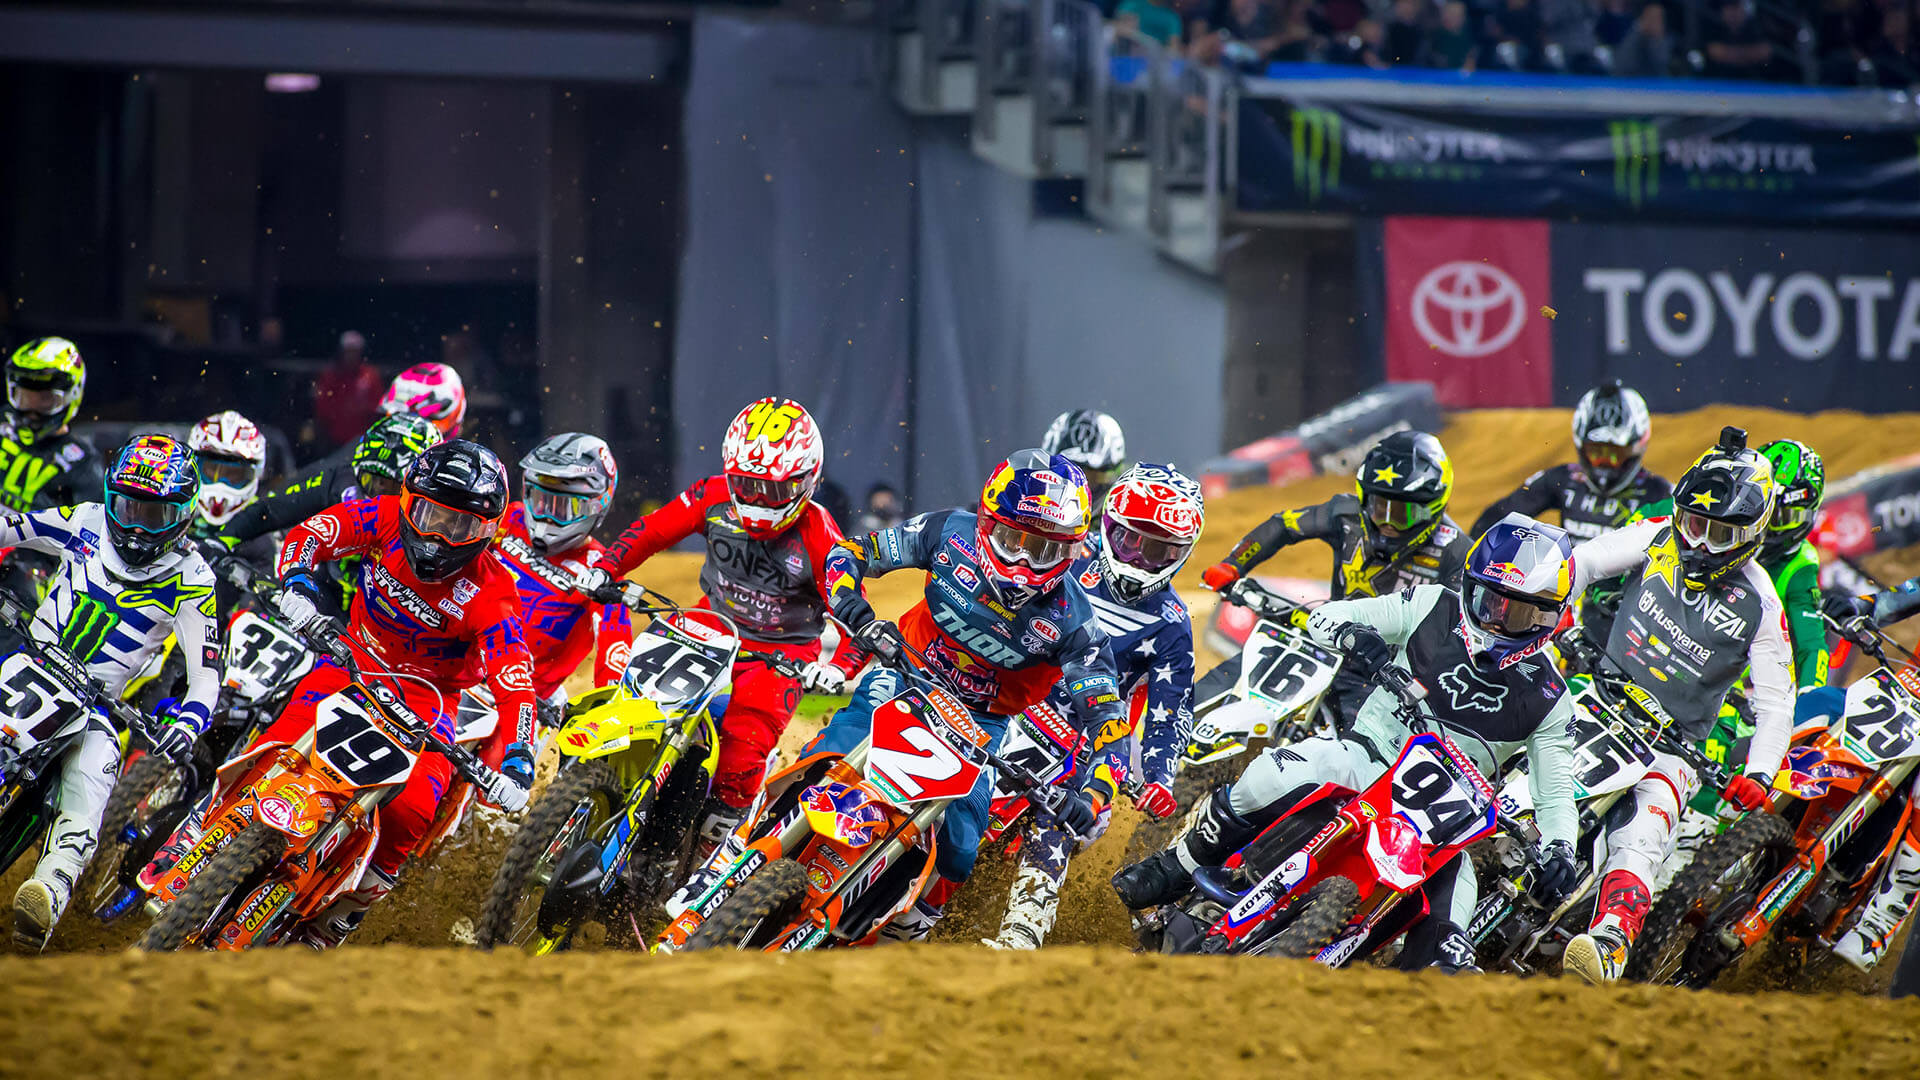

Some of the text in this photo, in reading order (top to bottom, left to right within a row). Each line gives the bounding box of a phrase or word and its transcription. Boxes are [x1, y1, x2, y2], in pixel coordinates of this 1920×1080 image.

[746, 402, 805, 443] 46
[1036, 473, 1059, 485] BELL
[1017, 502, 1065, 521] Red Bull
[379, 566, 406, 594] ROCKY
[404, 588, 442, 620] MOUNTAIN
[936, 578, 969, 610] MOTOREX
[957, 567, 978, 589] 100%
[1483, 568, 1526, 587] Red Bull
[934, 601, 1025, 669] THOR
[1035, 620, 1058, 641] BELL
[1650, 602, 1711, 662] Husqvarna
[233, 623, 304, 688] 33
[628, 641, 723, 699] 46
[1248, 644, 1318, 702] 16
[0, 664, 87, 742] 51
[931, 693, 981, 747] RENTHAL
[1845, 694, 1915, 759] 25
[316, 706, 411, 787] 19
[929, 710, 962, 748] MONSTER
[1023, 717, 1051, 747] MONSTER
[320, 767, 342, 785] KTM
[871, 726, 963, 798] 2
[1392, 760, 1474, 846] 94
[178, 827, 225, 874] GALFER
[599, 843, 628, 890] DUNLOP
[246, 883, 289, 932] GALFER
[1238, 871, 1286, 919] DUNLOP
[1777, 870, 1815, 911] MOTOREX
